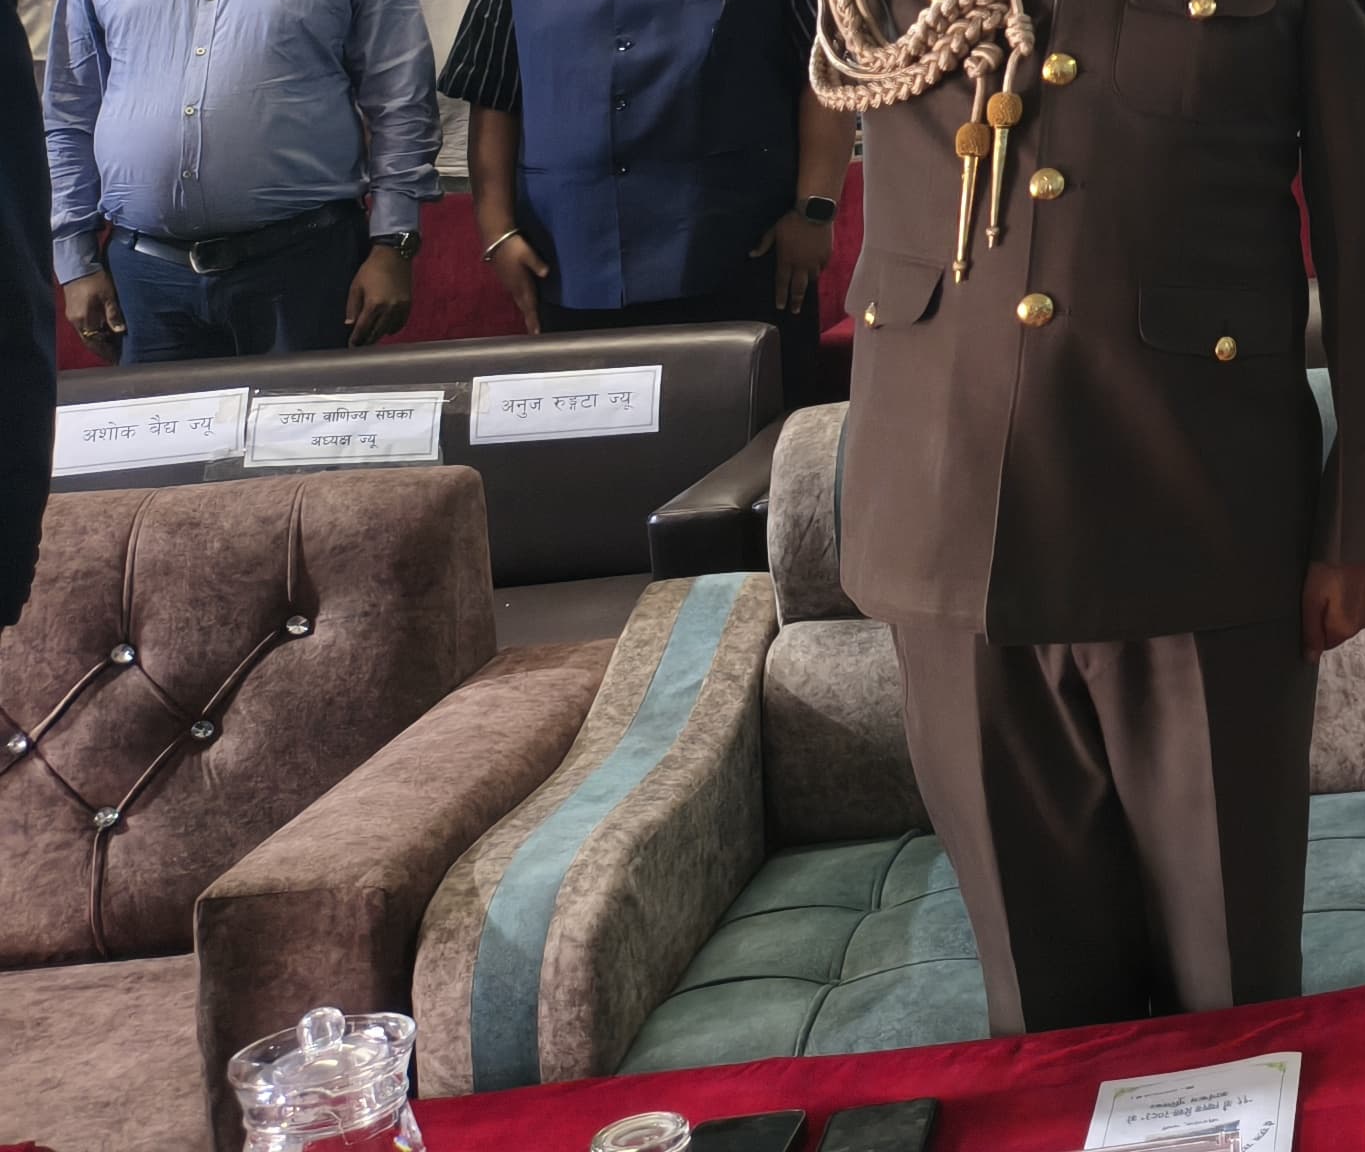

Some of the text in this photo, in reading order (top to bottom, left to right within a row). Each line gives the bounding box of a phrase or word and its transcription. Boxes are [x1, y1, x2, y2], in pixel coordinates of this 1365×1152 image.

[502, 398, 544, 418] अनुज
[608, 391, 633, 410] ज्यू
[280, 409, 315, 424] उद्योग
[83, 415, 216, 442] अशोक वैद्य ज्यू
[359, 434, 377, 448] ज्यू
